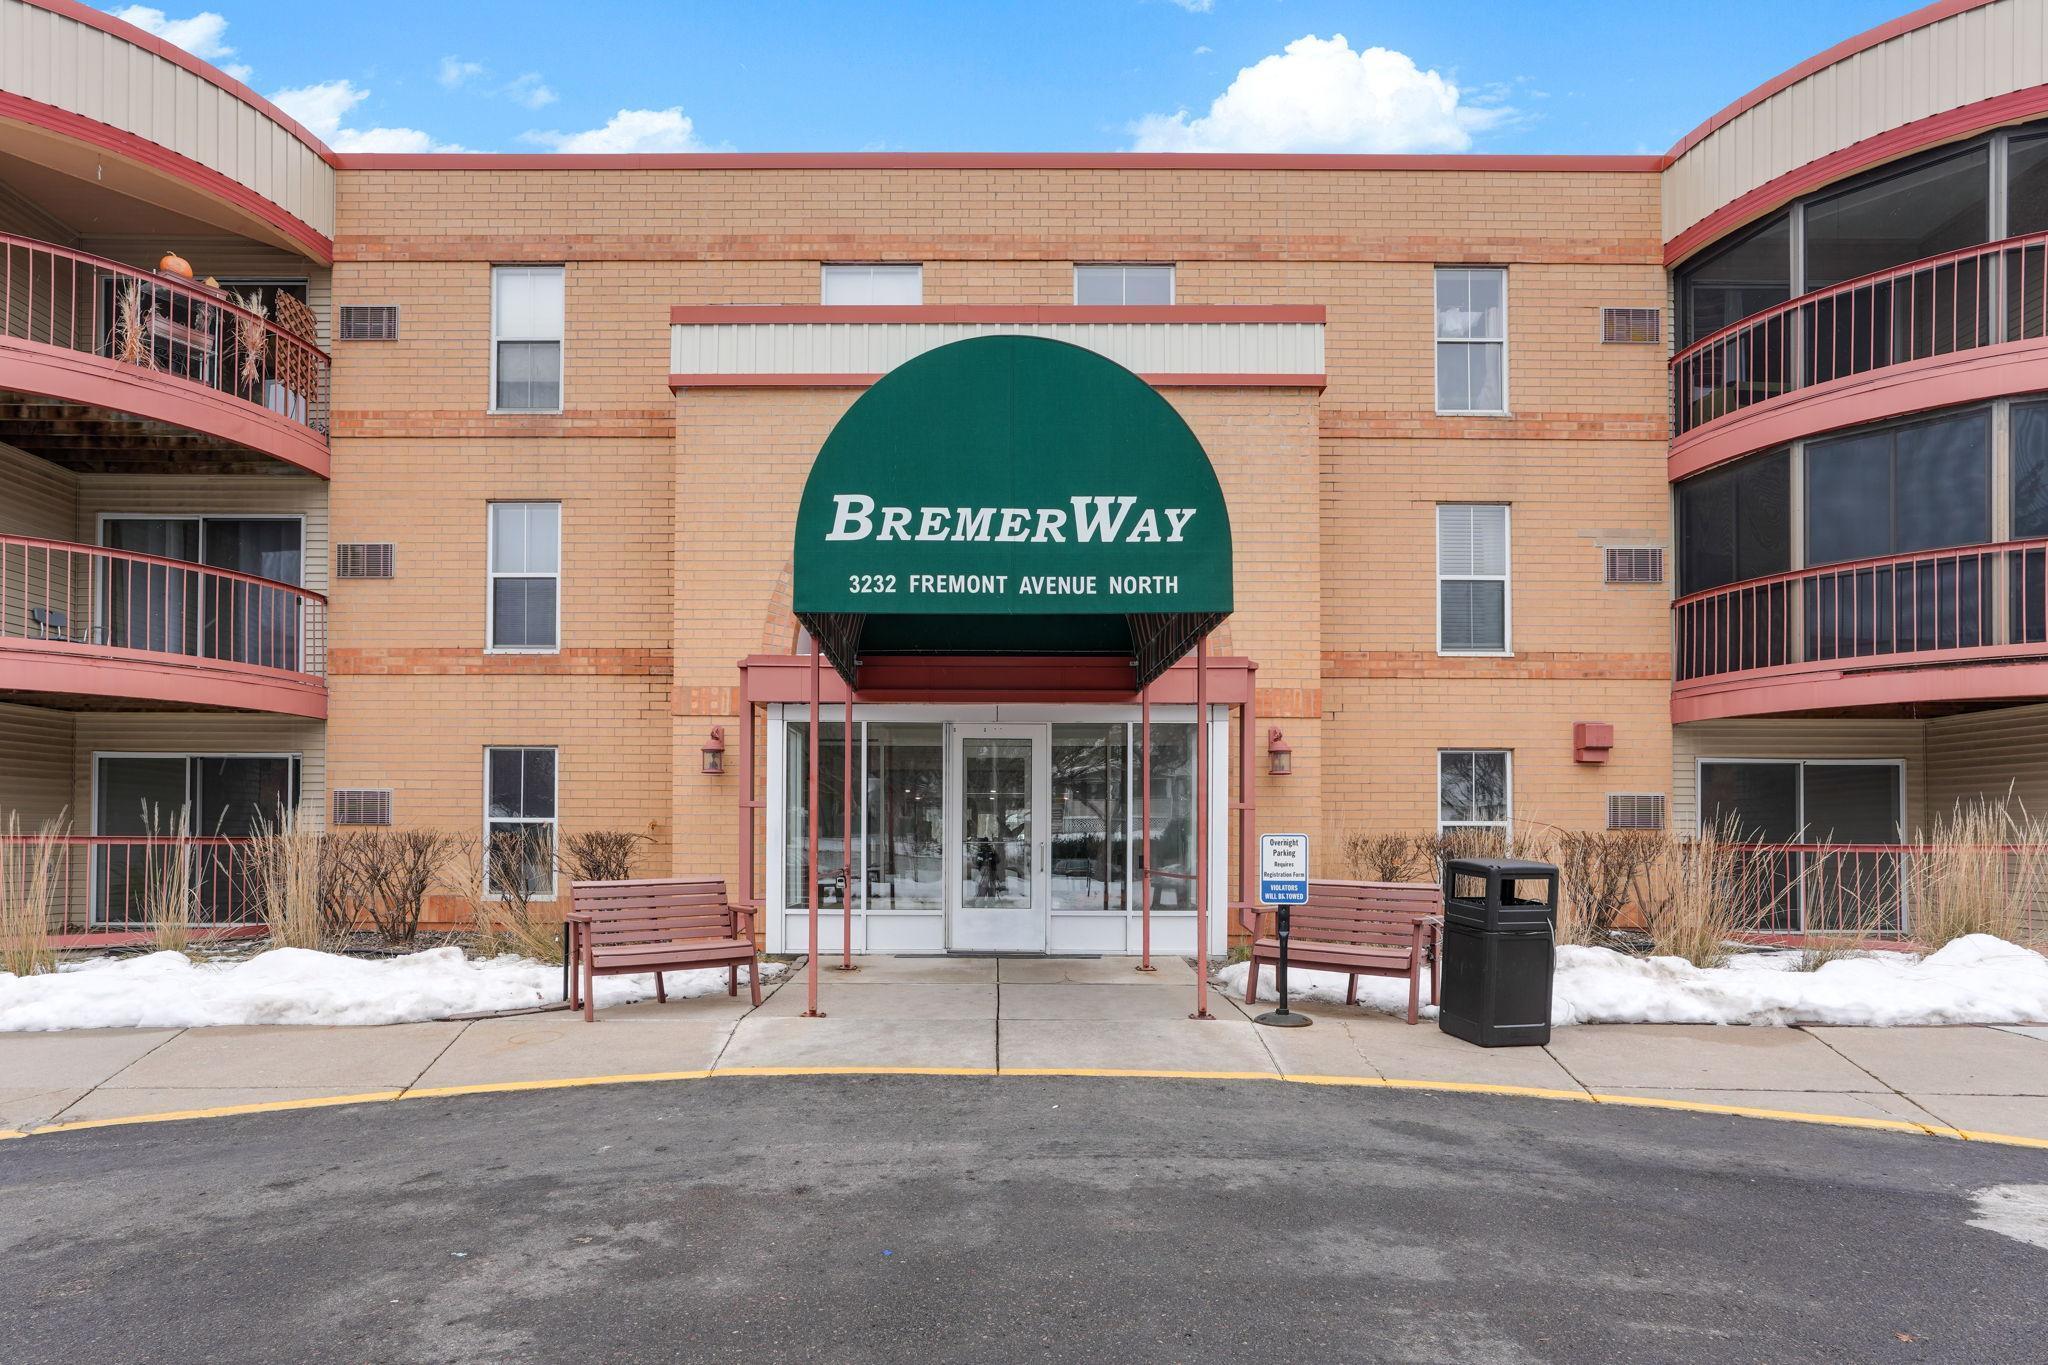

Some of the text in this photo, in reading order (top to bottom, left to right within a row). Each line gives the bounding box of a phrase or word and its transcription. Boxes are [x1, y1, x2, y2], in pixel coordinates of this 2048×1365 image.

[849, 574, 1179, 595] 3232 FREMONT AVENUE NORTH
[1270, 839, 1298, 848] Overnight
[1272, 850, 1296, 858] Parking
